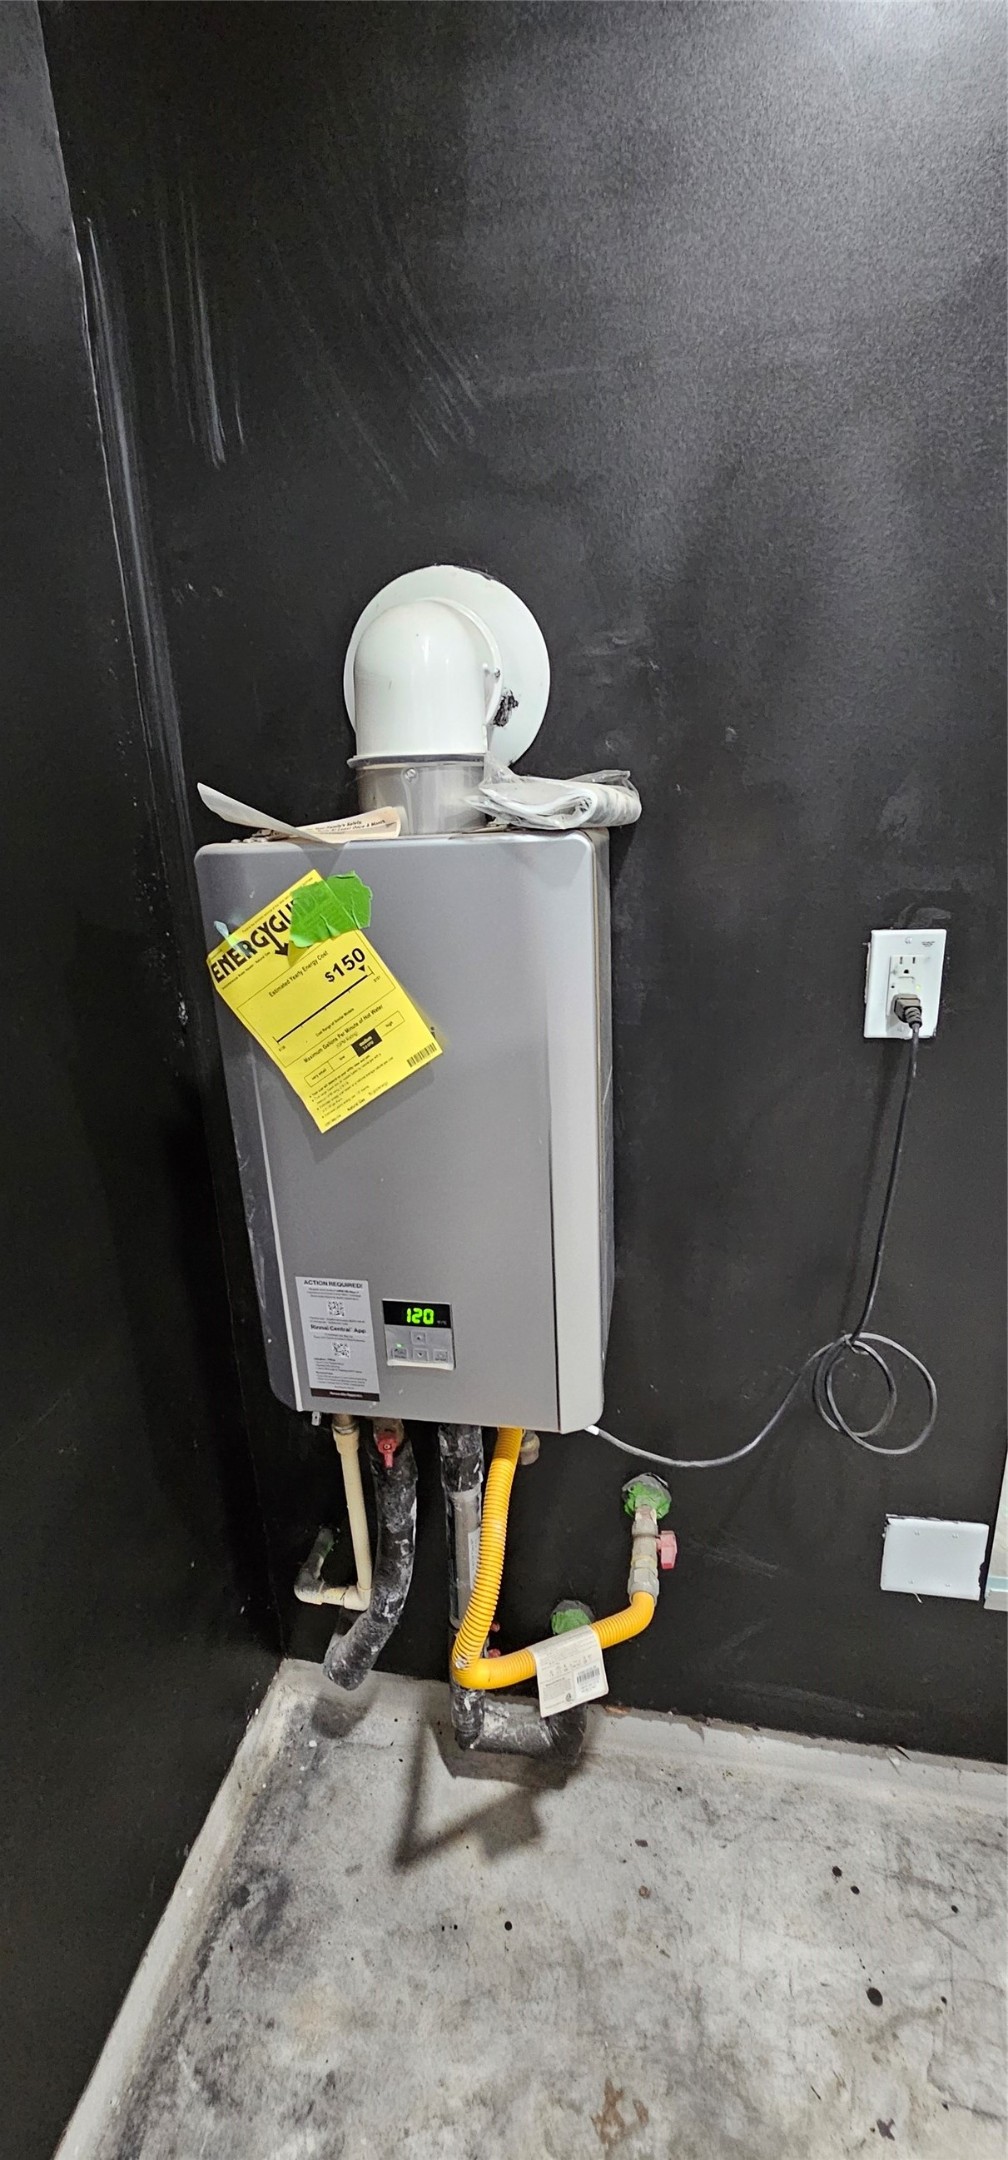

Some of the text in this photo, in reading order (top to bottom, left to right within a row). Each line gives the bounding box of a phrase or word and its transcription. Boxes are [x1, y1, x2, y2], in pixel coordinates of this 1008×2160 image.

[268, 951, 328, 998] Estimated Yearly Energy Cost
[324, 947, 365, 982] $150
[303, 1048, 323, 1063] Maximum
[322, 1037, 338, 1050] Gallons
[344, 1022, 359, 1033] Minute
[363, 1012, 372, 1020] Hot
[371, 1004, 383, 1015] Water
[406, 1307, 435, 1325] 120
